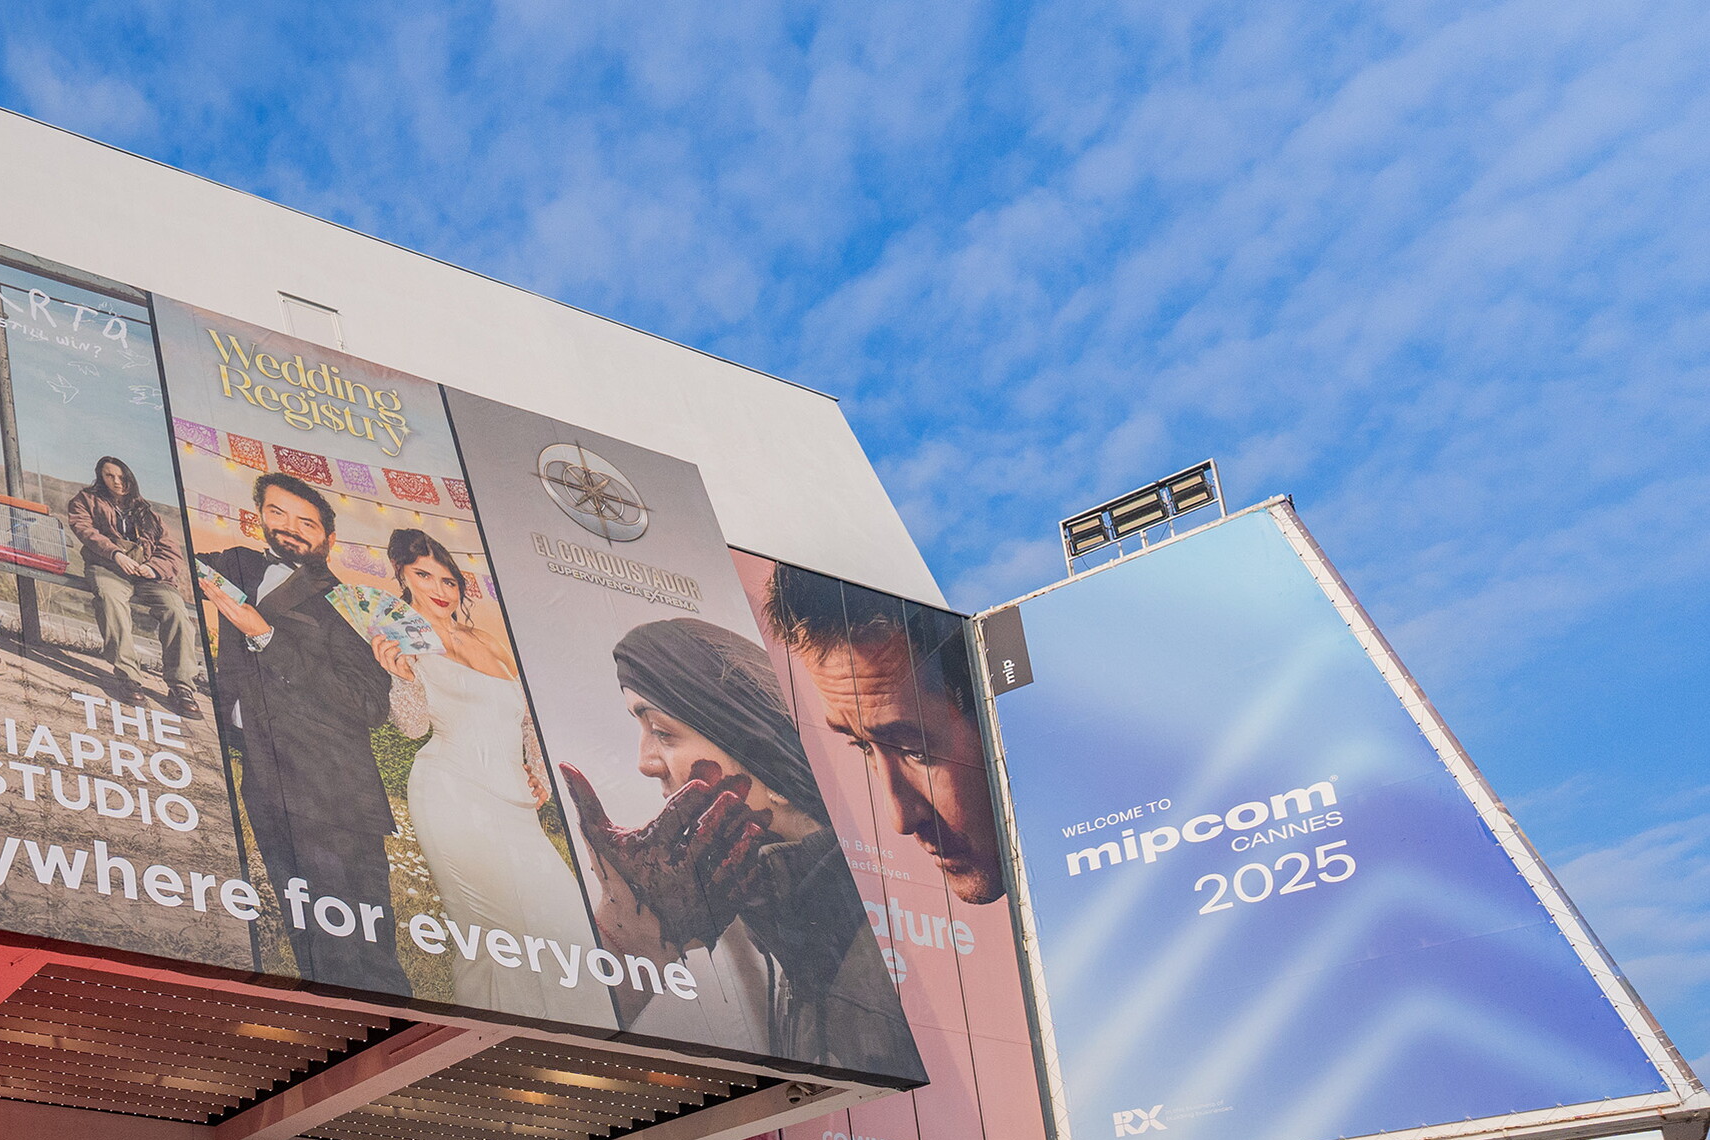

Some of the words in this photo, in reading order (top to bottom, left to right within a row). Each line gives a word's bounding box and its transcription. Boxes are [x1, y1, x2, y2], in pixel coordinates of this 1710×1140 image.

[205, 327, 407, 428] Wedding
[531, 532, 556, 560] EL
[557, 540, 702, 600] CONQUISTADOR
[547, 562, 643, 597] SUPERVIVENCIA
[642, 588, 700, 613] EXTREMA
[1002, 659, 1016, 685] mip
[71, 690, 188, 750] THE
[1062, 806, 1144, 839] WELCOME
[1146, 798, 1172, 815] TO
[1230, 811, 1344, 852] CANNES
[1194, 839, 1357, 915] 2025
[283, 877, 385, 942] for
[409, 914, 700, 1001] everyone
[1112, 1104, 1168, 1138] RX
